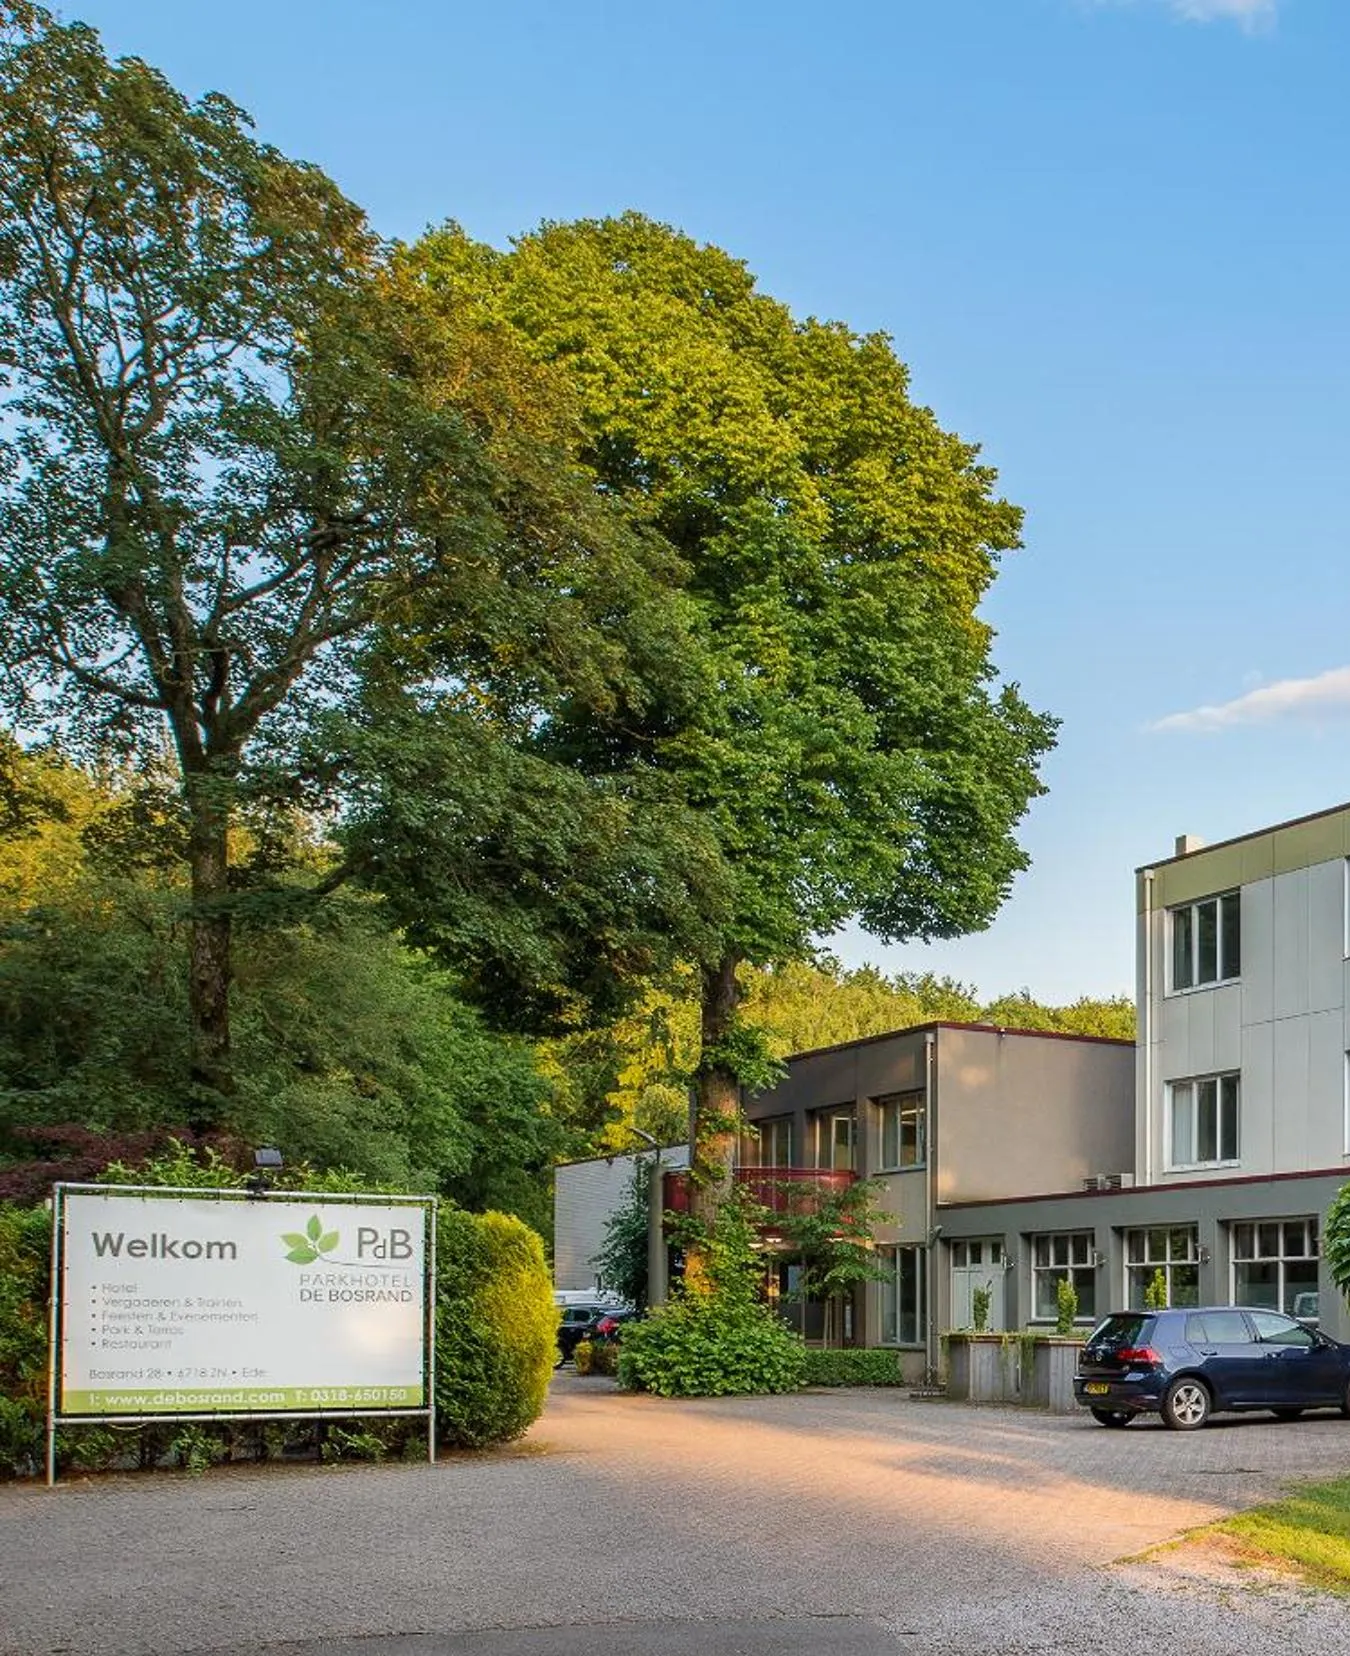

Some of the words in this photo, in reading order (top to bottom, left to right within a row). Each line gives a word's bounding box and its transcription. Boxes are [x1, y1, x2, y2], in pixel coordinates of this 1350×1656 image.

[91, 1232, 237, 1260] Welkom
[357, 1227, 413, 1259] PdB
[300, 1274, 412, 1288] PARKHOTEL
[101, 1283, 138, 1294] Hotel
[300, 1289, 323, 1302] DE
[328, 1289, 412, 1302] BOSRAND
[102, 1299, 180, 1309] Vergaderen
[102, 1324, 131, 1335] Park
[102, 1338, 173, 1350] Restaurant
[89, 1368, 143, 1380] Bosrand
[105, 1390, 285, 1405] www.debosrand.com
[310, 1388, 407, 1401] 0318-650150
